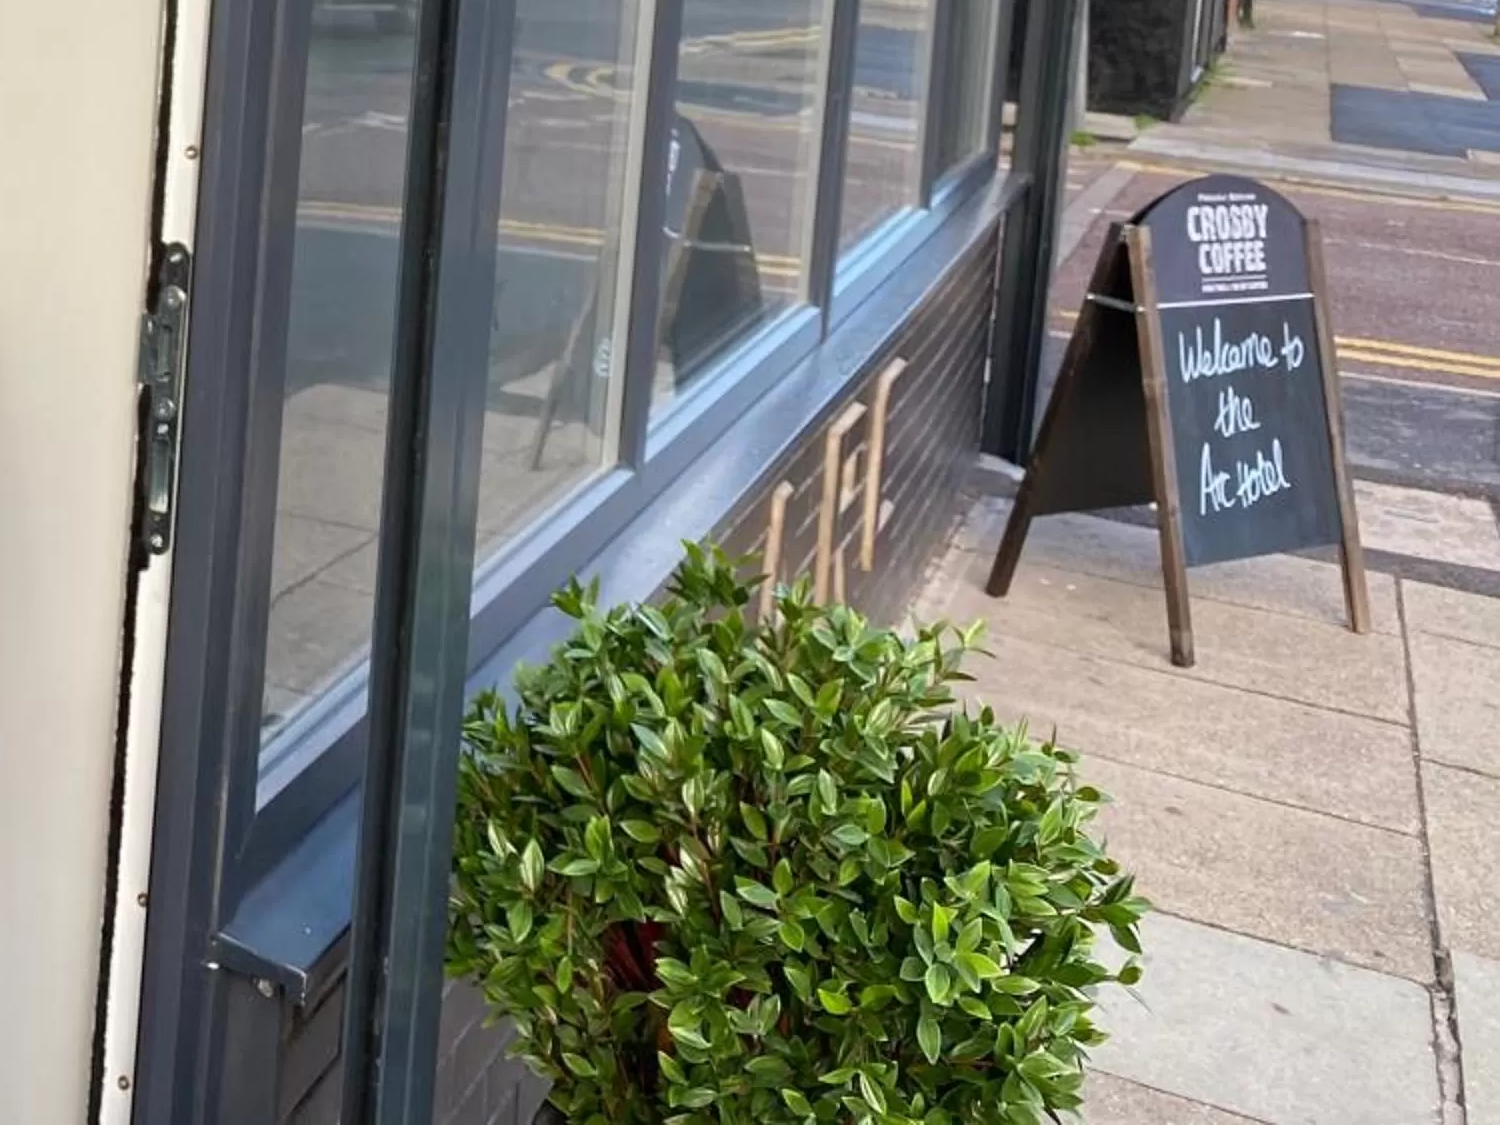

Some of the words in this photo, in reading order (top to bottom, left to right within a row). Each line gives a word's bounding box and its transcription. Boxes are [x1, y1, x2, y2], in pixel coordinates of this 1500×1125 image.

[1187, 203, 1269, 242] CROSBY
[1199, 241, 1267, 274] COFFEE
[1178, 317, 1279, 384] Welcome
[1280, 322, 1305, 372] to
[1213, 385, 1262, 438] the
